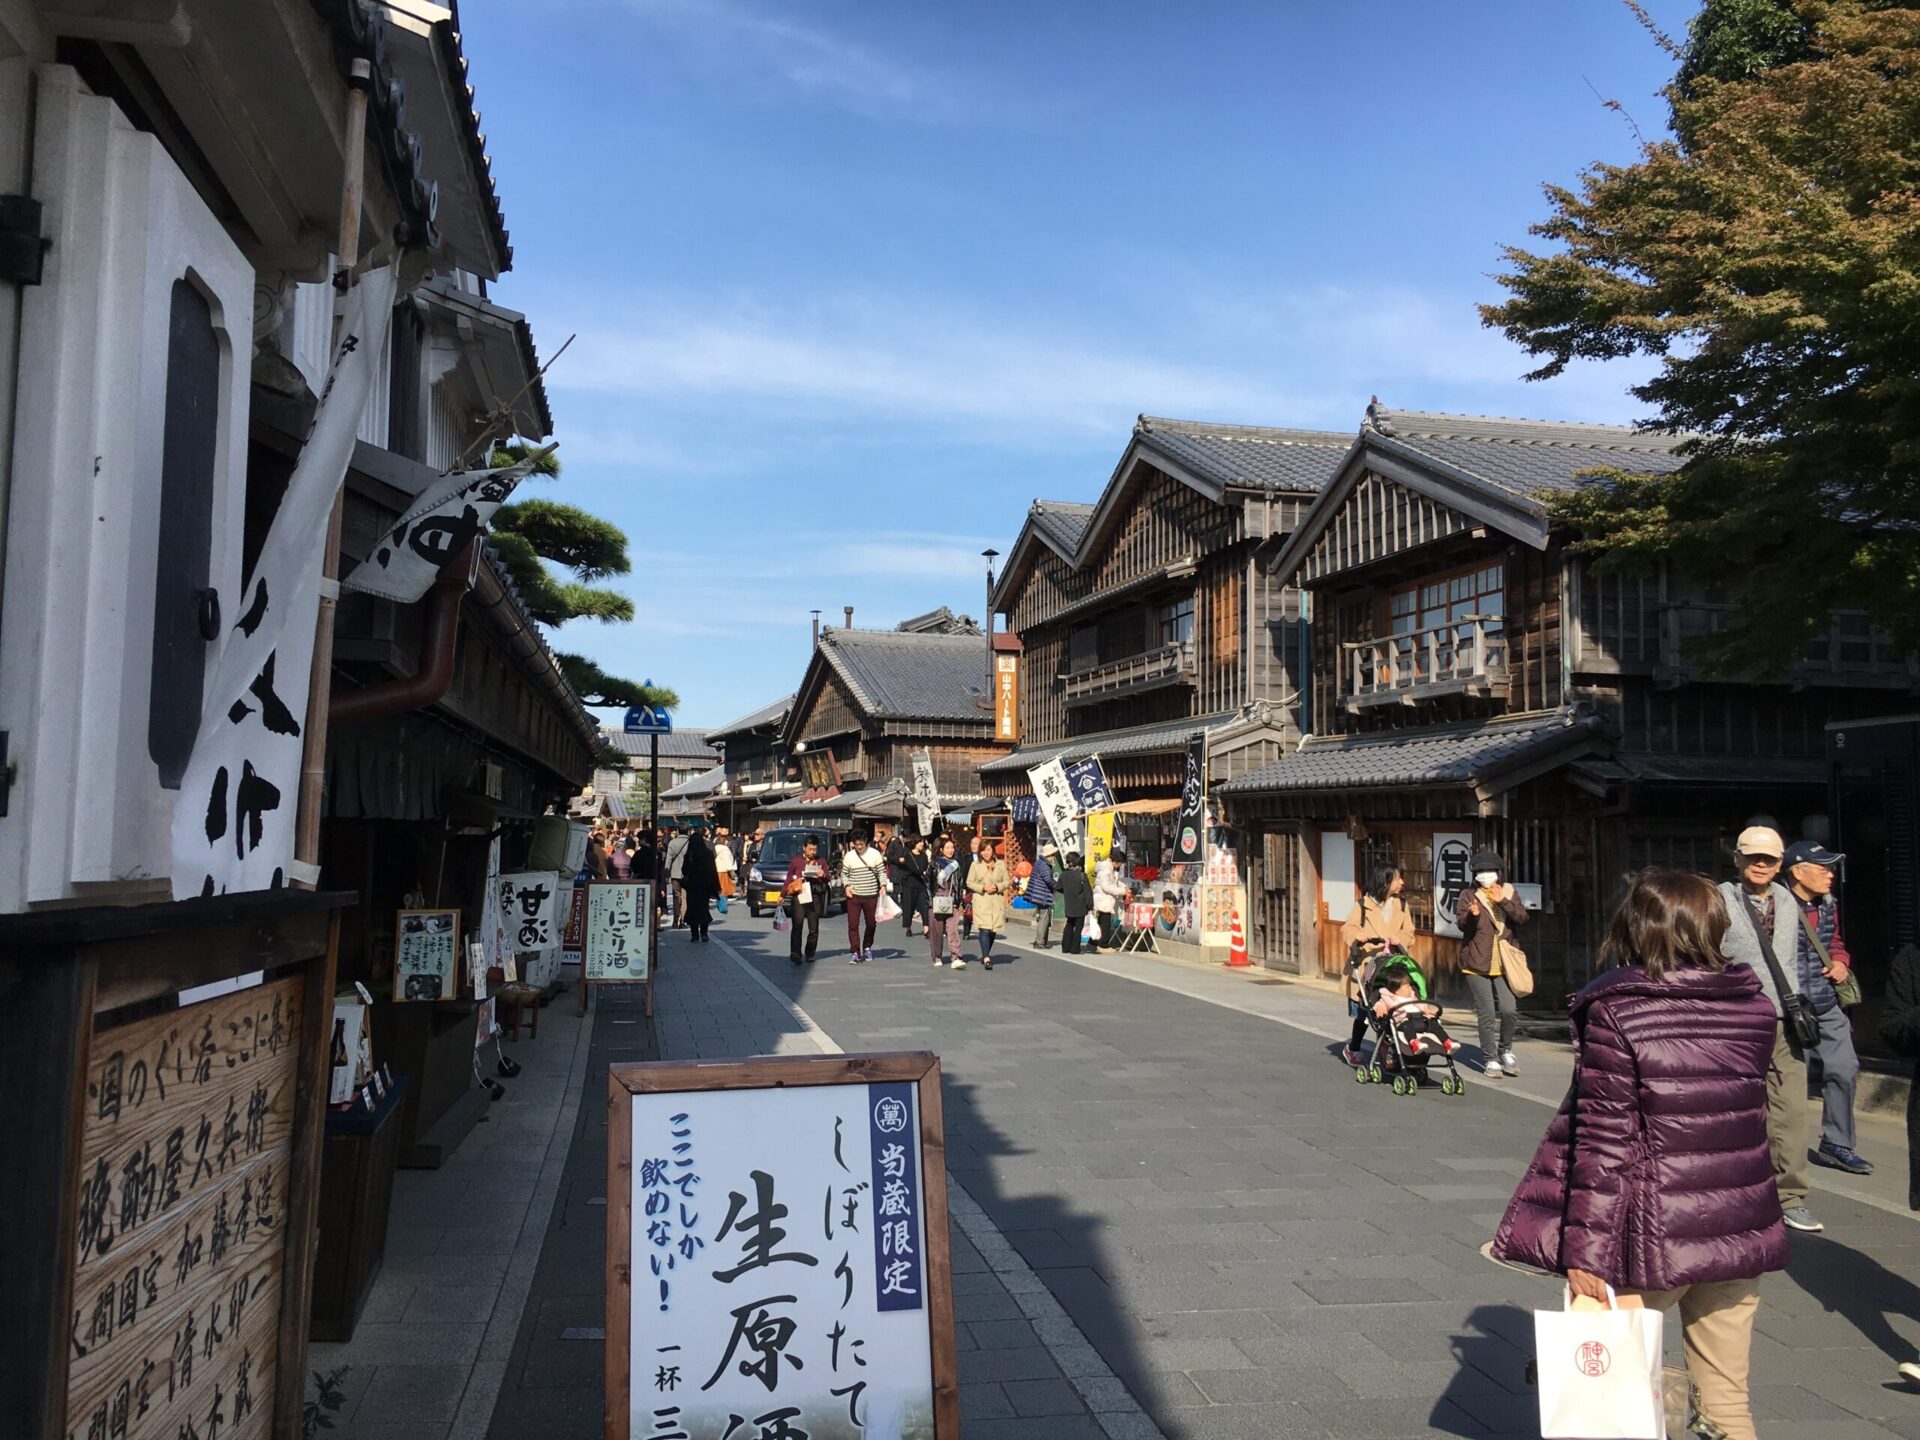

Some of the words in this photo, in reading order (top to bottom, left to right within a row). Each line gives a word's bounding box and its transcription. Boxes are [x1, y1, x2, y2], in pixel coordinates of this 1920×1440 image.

[1043, 776, 1082, 856] 萬金丹
[606, 910, 632, 969] にごり酒
[878, 1102, 904, 1130] 萬
[670, 1113, 704, 1260] ここでしか
[877, 1142, 917, 1295] 当蔵限定
[824, 1115, 869, 1427] しぼりたて
[69, 1357, 155, 1440] 間国宝
[1580, 1341, 1607, 1377] 神宮
